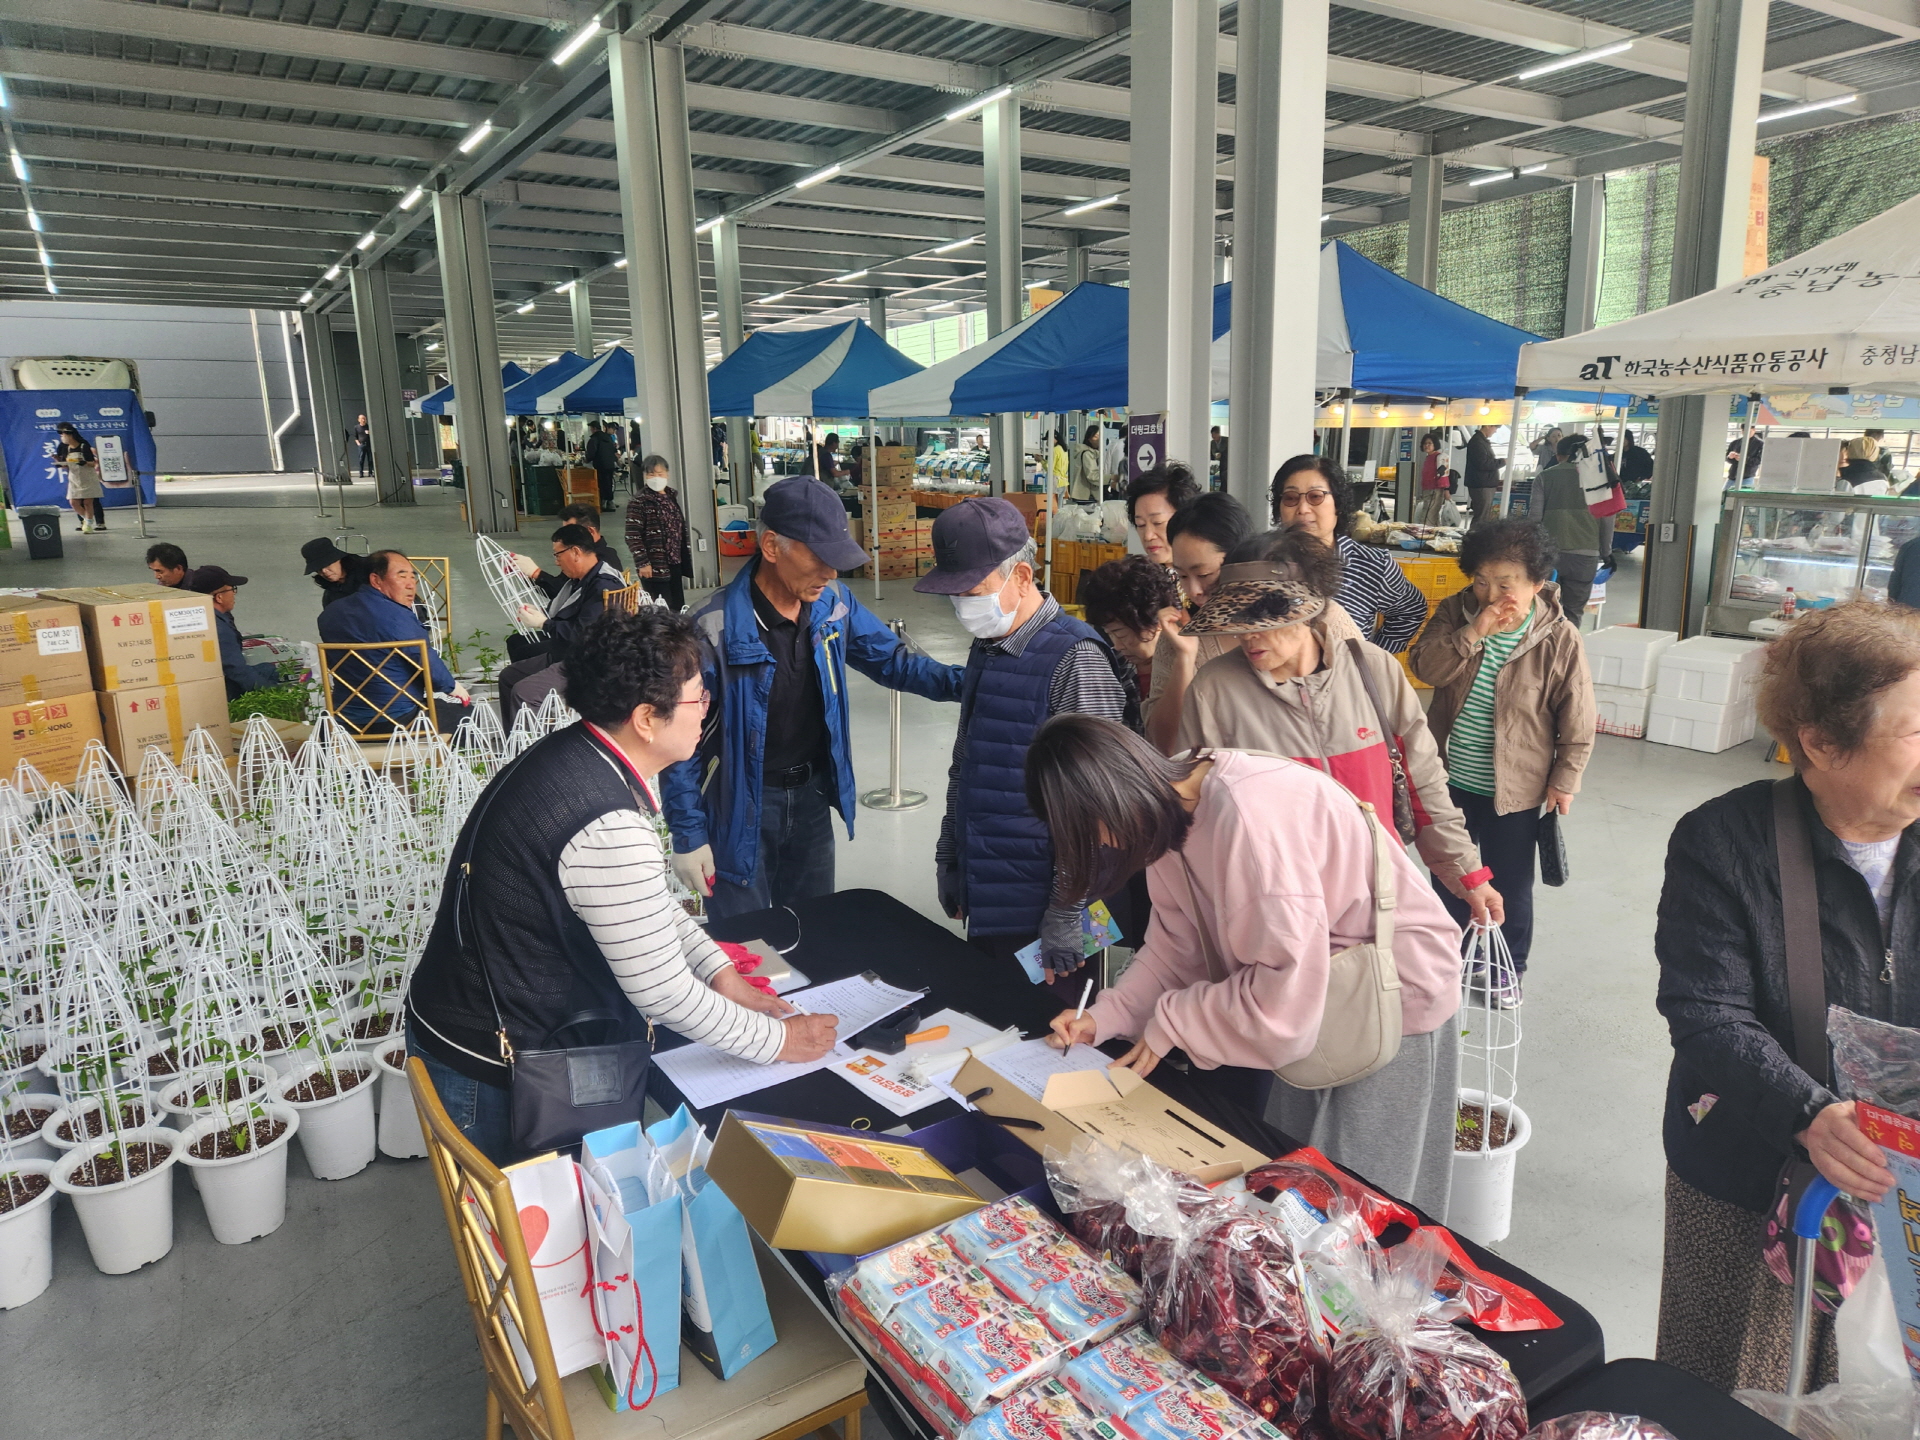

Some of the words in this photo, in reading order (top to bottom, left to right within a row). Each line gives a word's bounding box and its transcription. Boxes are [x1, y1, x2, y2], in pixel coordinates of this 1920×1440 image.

[1579, 355, 1621, 380] aT
[1624, 347, 1829, 378] 한국농수산식품유통공사
[1860, 344, 1920, 366] 충청남
[1131, 423, 1164, 436] 더링크호텔
